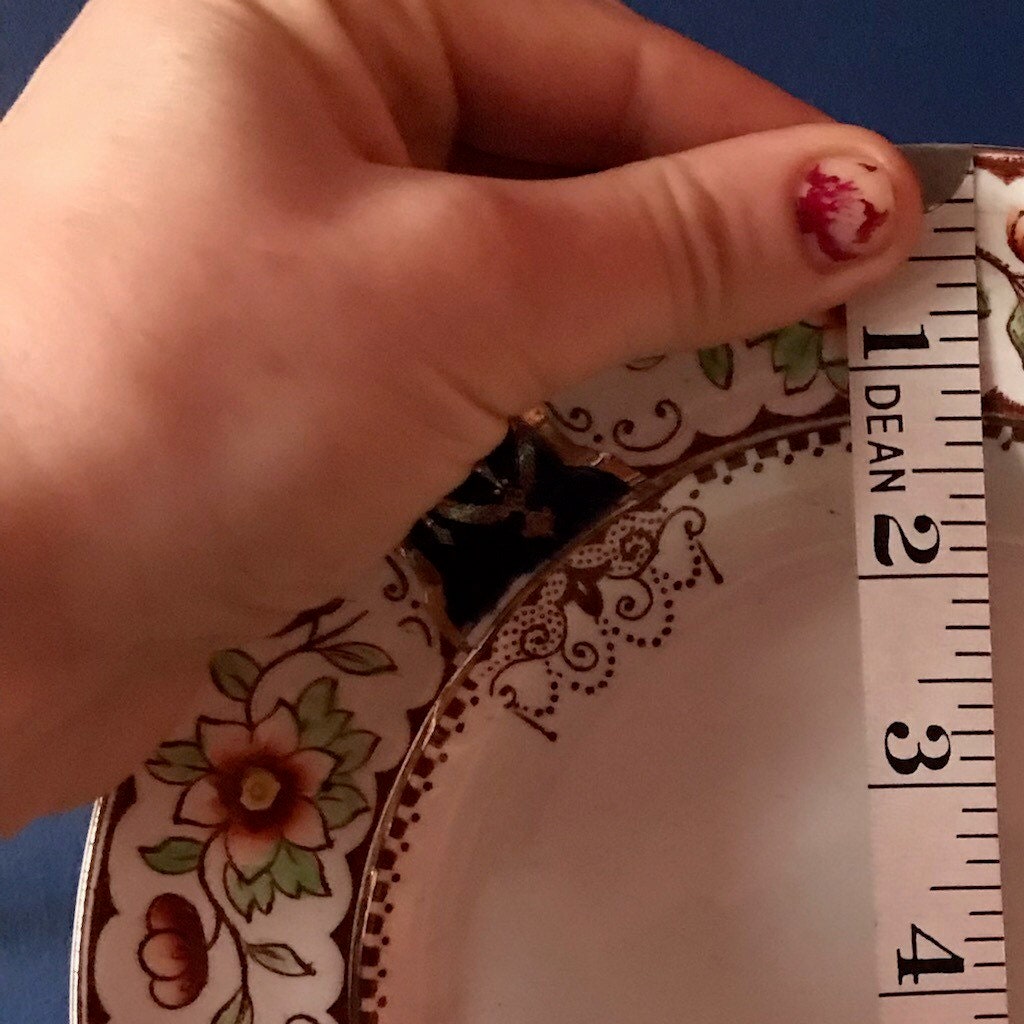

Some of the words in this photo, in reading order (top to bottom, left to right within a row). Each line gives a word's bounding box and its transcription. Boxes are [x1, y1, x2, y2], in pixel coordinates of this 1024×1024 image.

[863, 324, 930, 360] 1
[864, 385, 906, 492] DEAN
[873, 513, 941, 567] 2
[884, 721, 952, 775] 3
[896, 923, 965, 986] 4
